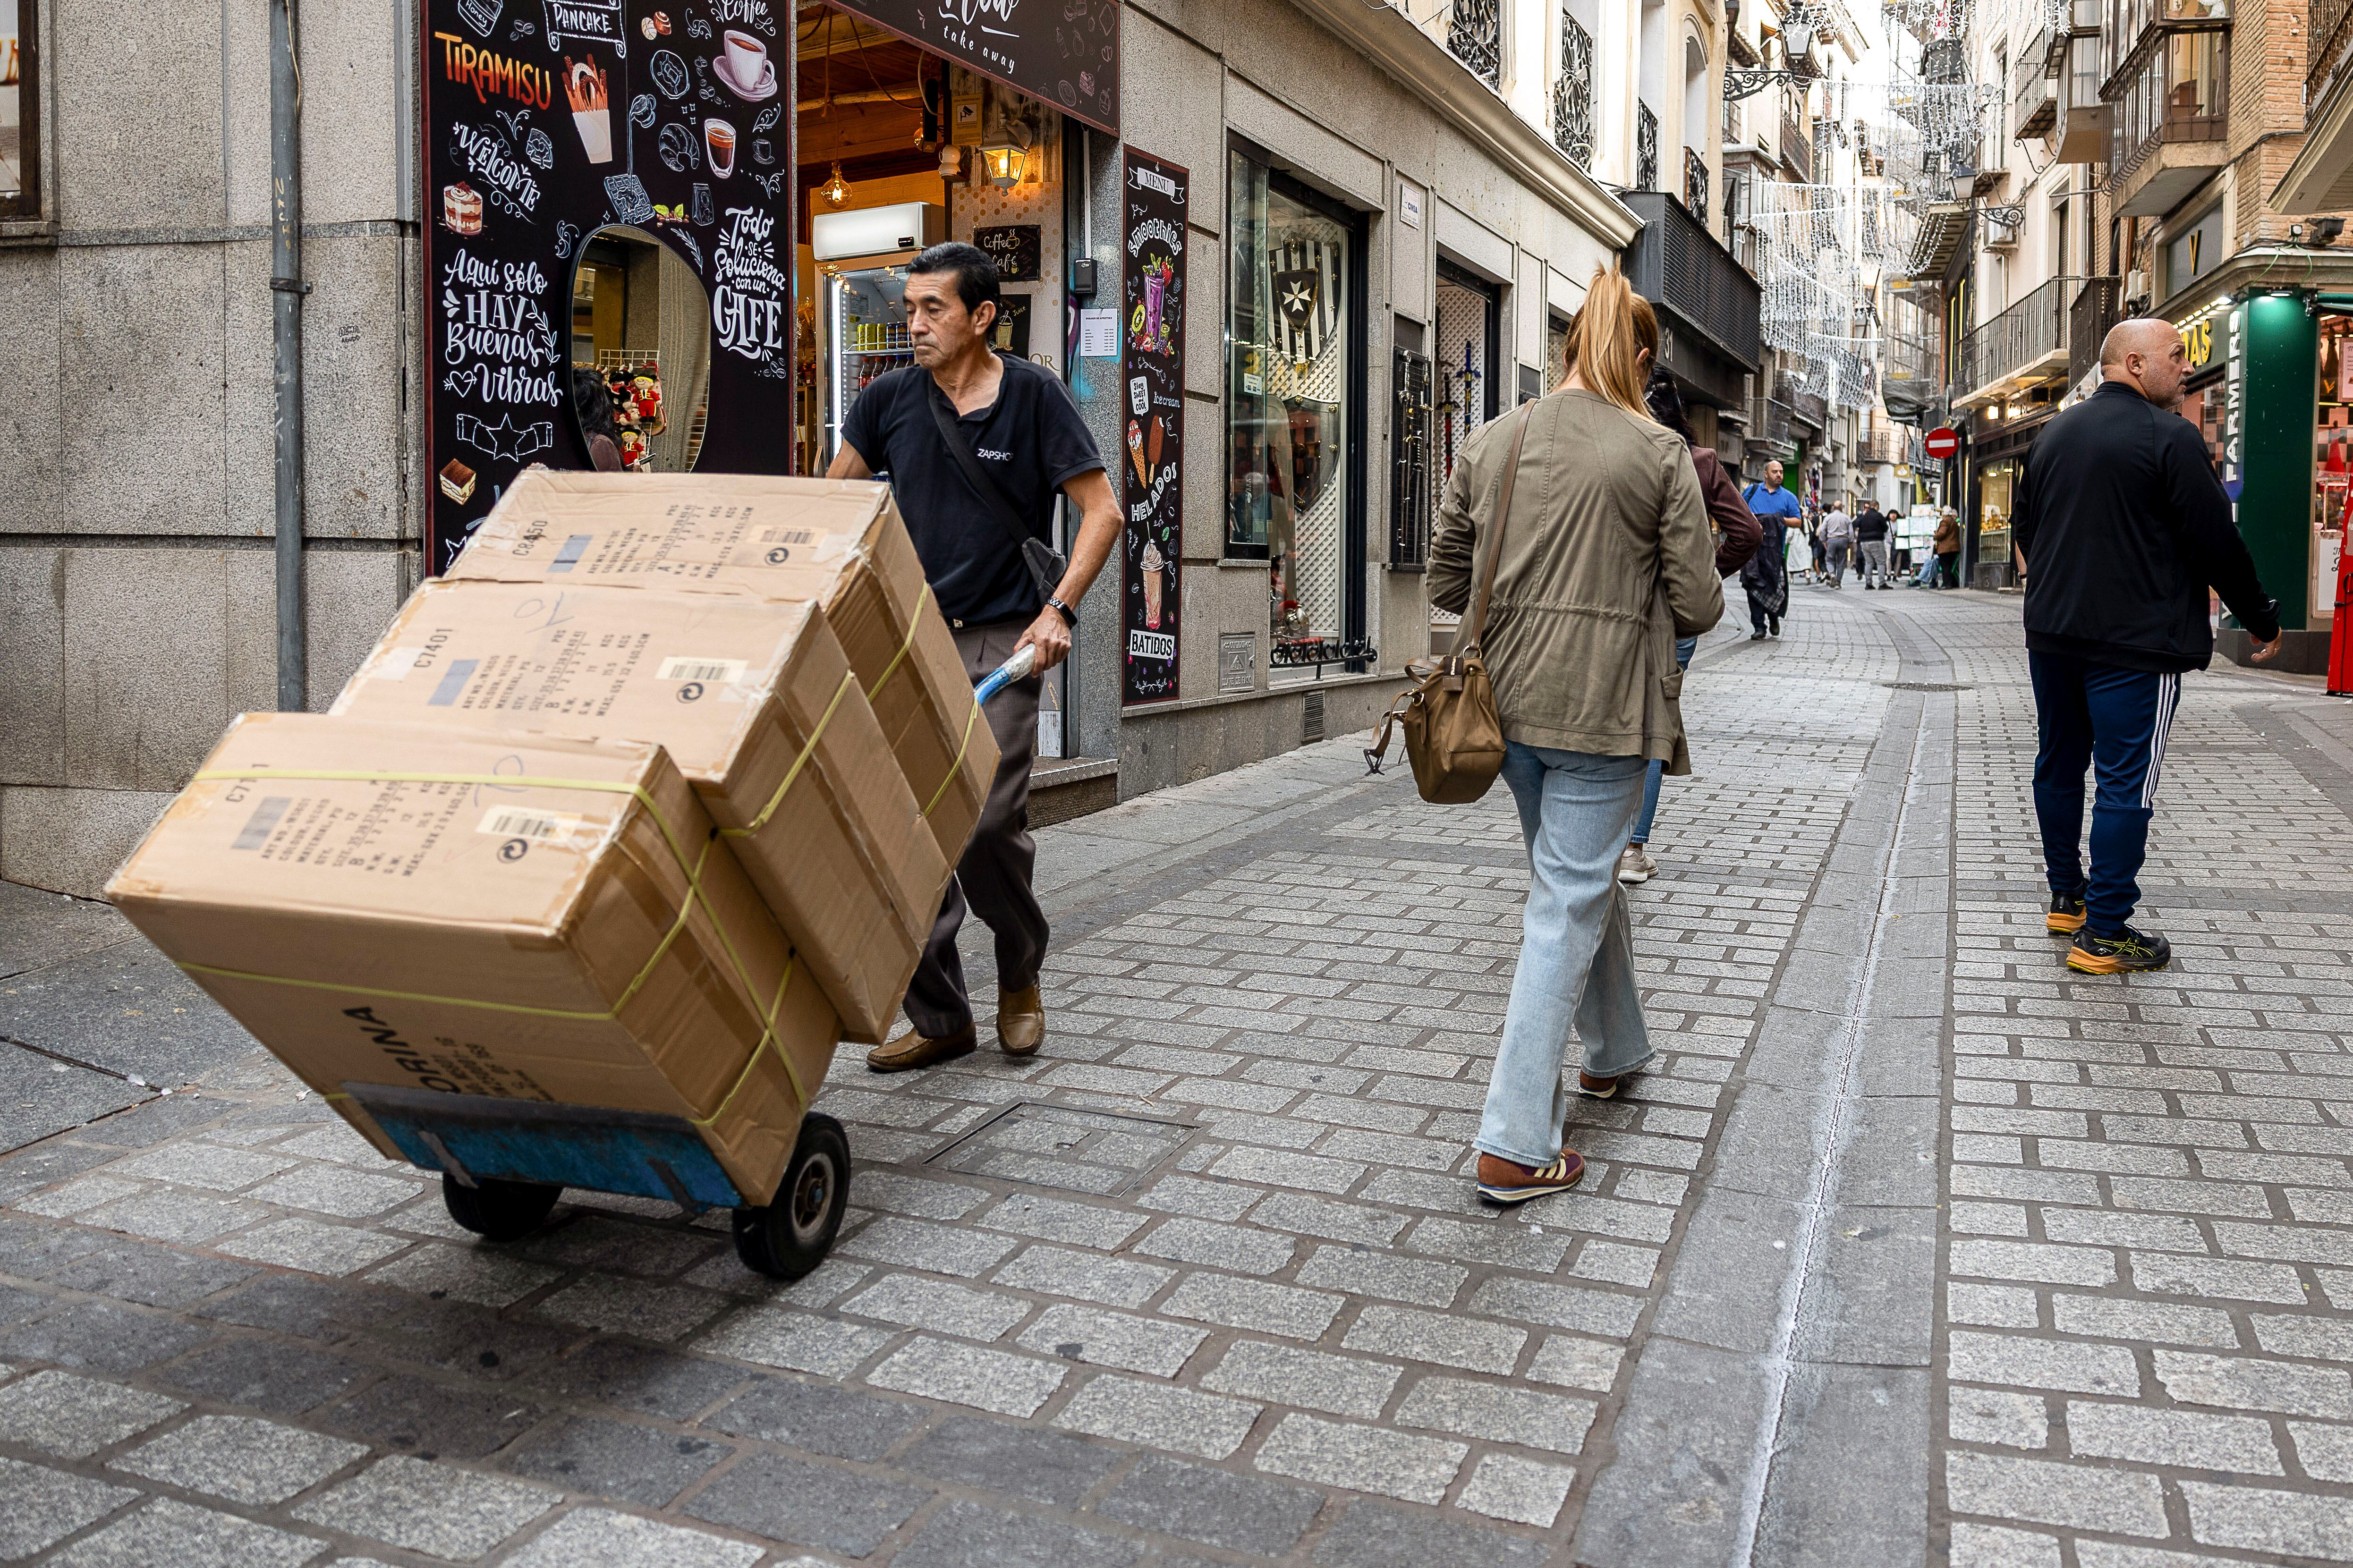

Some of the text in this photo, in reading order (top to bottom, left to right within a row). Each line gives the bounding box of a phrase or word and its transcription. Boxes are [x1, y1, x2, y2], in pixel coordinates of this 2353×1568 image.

[465, 1, 487, 27] Honey
[553, 3, 612, 33] PANCAKE
[944, 25, 1015, 74] take away
[459, 125, 540, 212] WELCOME
[1145, 172, 1169, 192] MENU
[725, 206, 774, 249] Todo
[984, 234, 1011, 251] Coffee
[443, 248, 499, 287] Aquí
[714, 237, 786, 290] Soluciona
[735, 277, 767, 294] con un
[465, 290, 528, 332] HAY
[714, 285, 782, 349] CAFÉ
[1012, 305, 1026, 316] Juice
[445, 322, 544, 367] Buenas
[474, 363, 563, 407] Vibras
[1134, 382, 1144, 390] Stay
[1134, 390, 1146, 399] SWEET
[2226, 311, 2241, 482] FARMERS
[1136, 402, 1147, 411] COOL
[1131, 462, 1176, 521] HELADOS
[414, 628, 453, 668] C7401
[1131, 633, 1172, 657] BATIDOS
